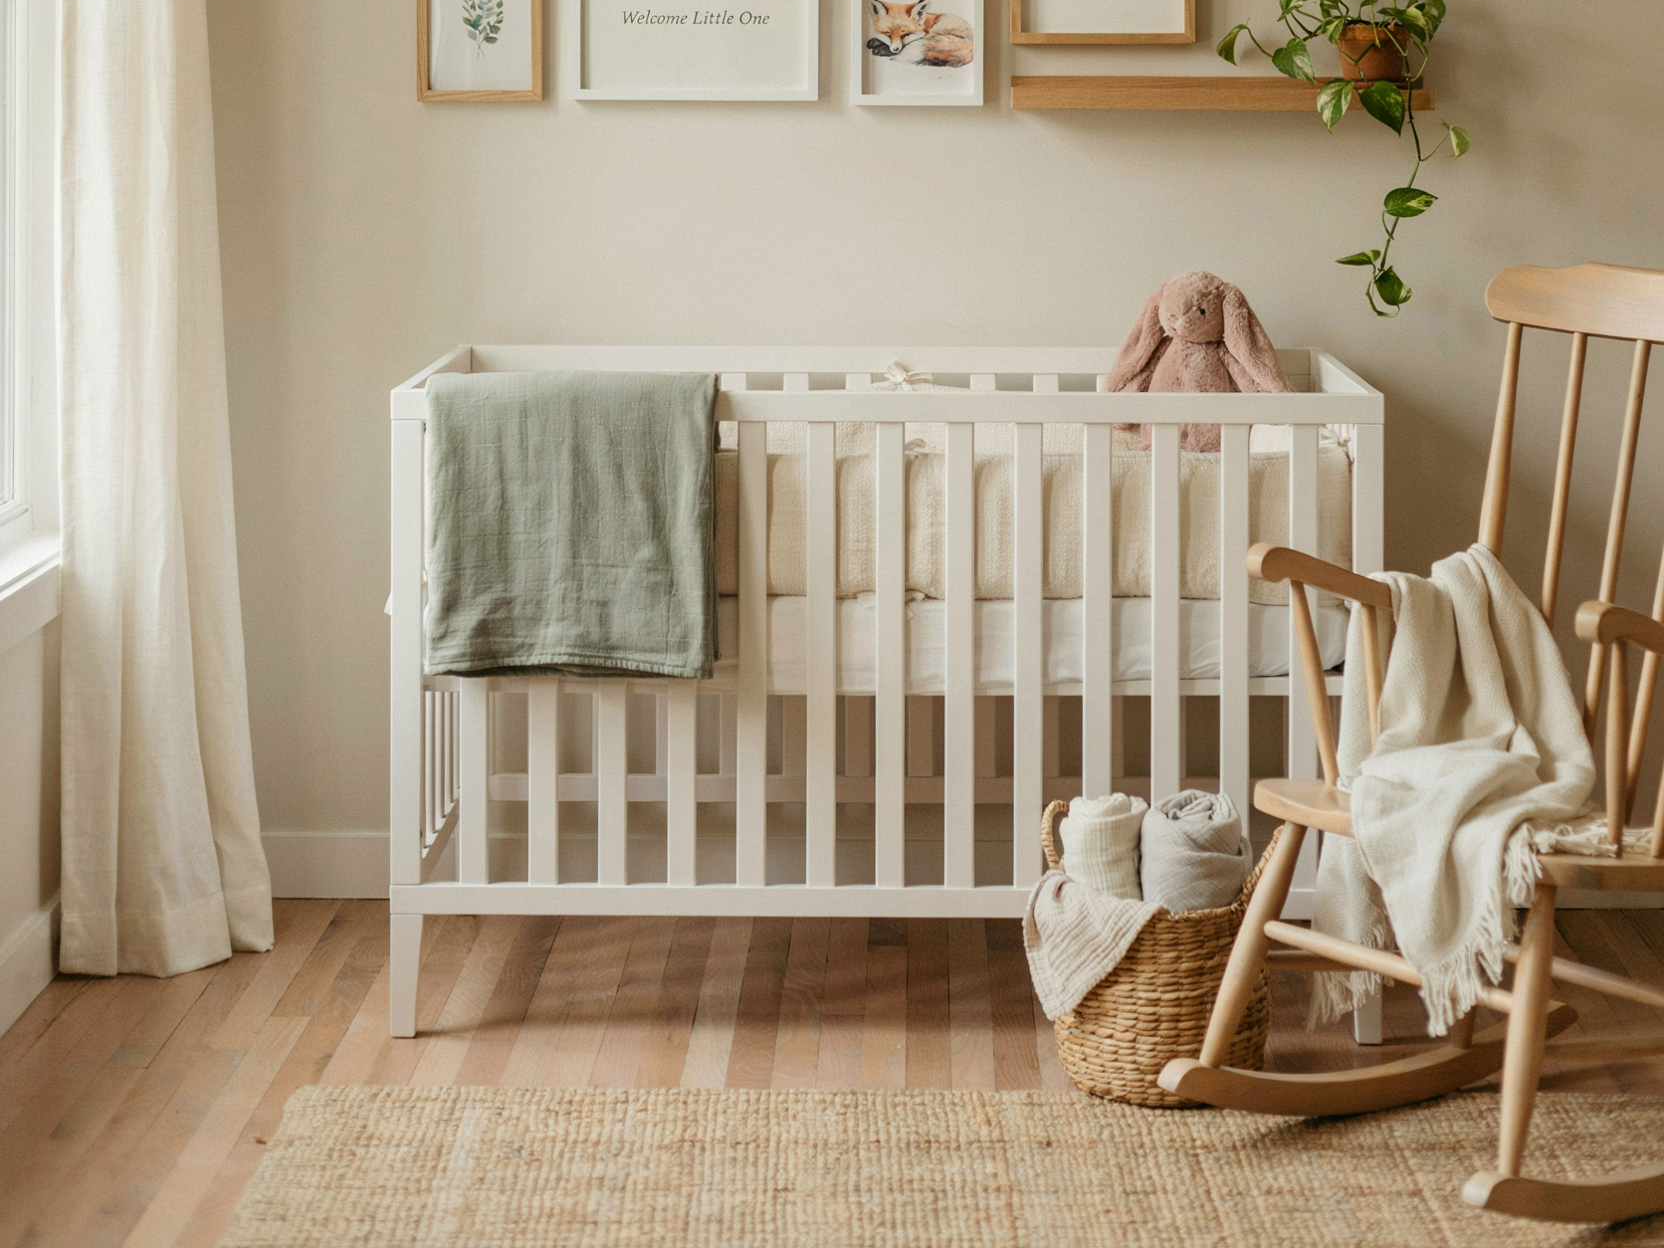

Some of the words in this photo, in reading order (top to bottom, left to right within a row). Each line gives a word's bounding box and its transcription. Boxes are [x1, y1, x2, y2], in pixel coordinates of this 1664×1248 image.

[621, 9, 688, 25] Welcome
[692, 10, 735, 25] Little
[739, 10, 770, 25] One
